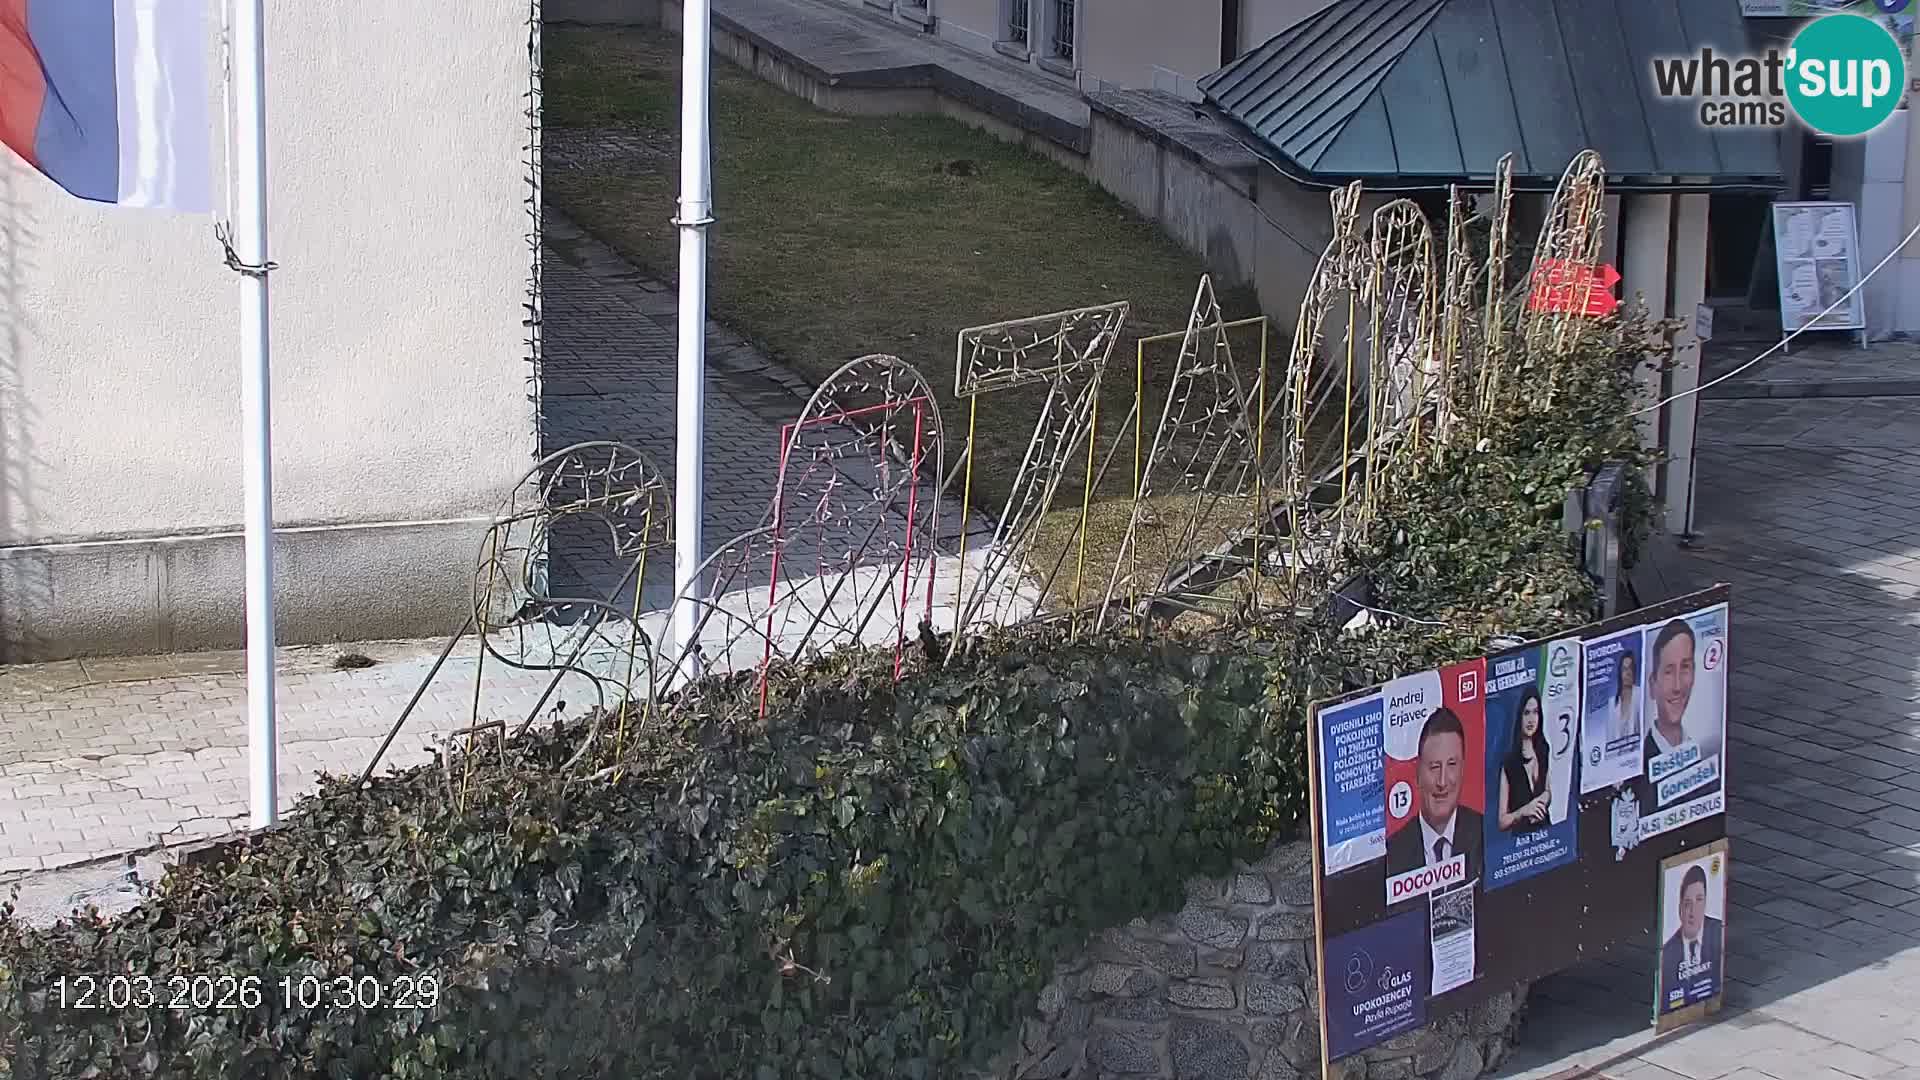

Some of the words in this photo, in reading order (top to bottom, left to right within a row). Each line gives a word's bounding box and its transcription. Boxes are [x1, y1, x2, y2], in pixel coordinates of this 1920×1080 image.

[1462, 681, 1474, 693] SD
[1390, 688, 1424, 709] Andrej
[1330, 715, 1364, 736] DVIGNILI
[1365, 711, 1382, 724] SMO
[1390, 708, 1428, 727] Erjavec
[1335, 724, 1379, 747] POKOJNINE
[1338, 747, 1347, 758] IN
[1335, 763, 1371, 782] DOMOVIH
[1393, 790, 1408, 809] 13
[1689, 796, 1722, 818] FOKUS
[1393, 861, 1462, 897] DOGOVOR
[1391, 971, 1412, 987] GLAS
[1353, 984, 1412, 1016] UPOKOJENCEV
